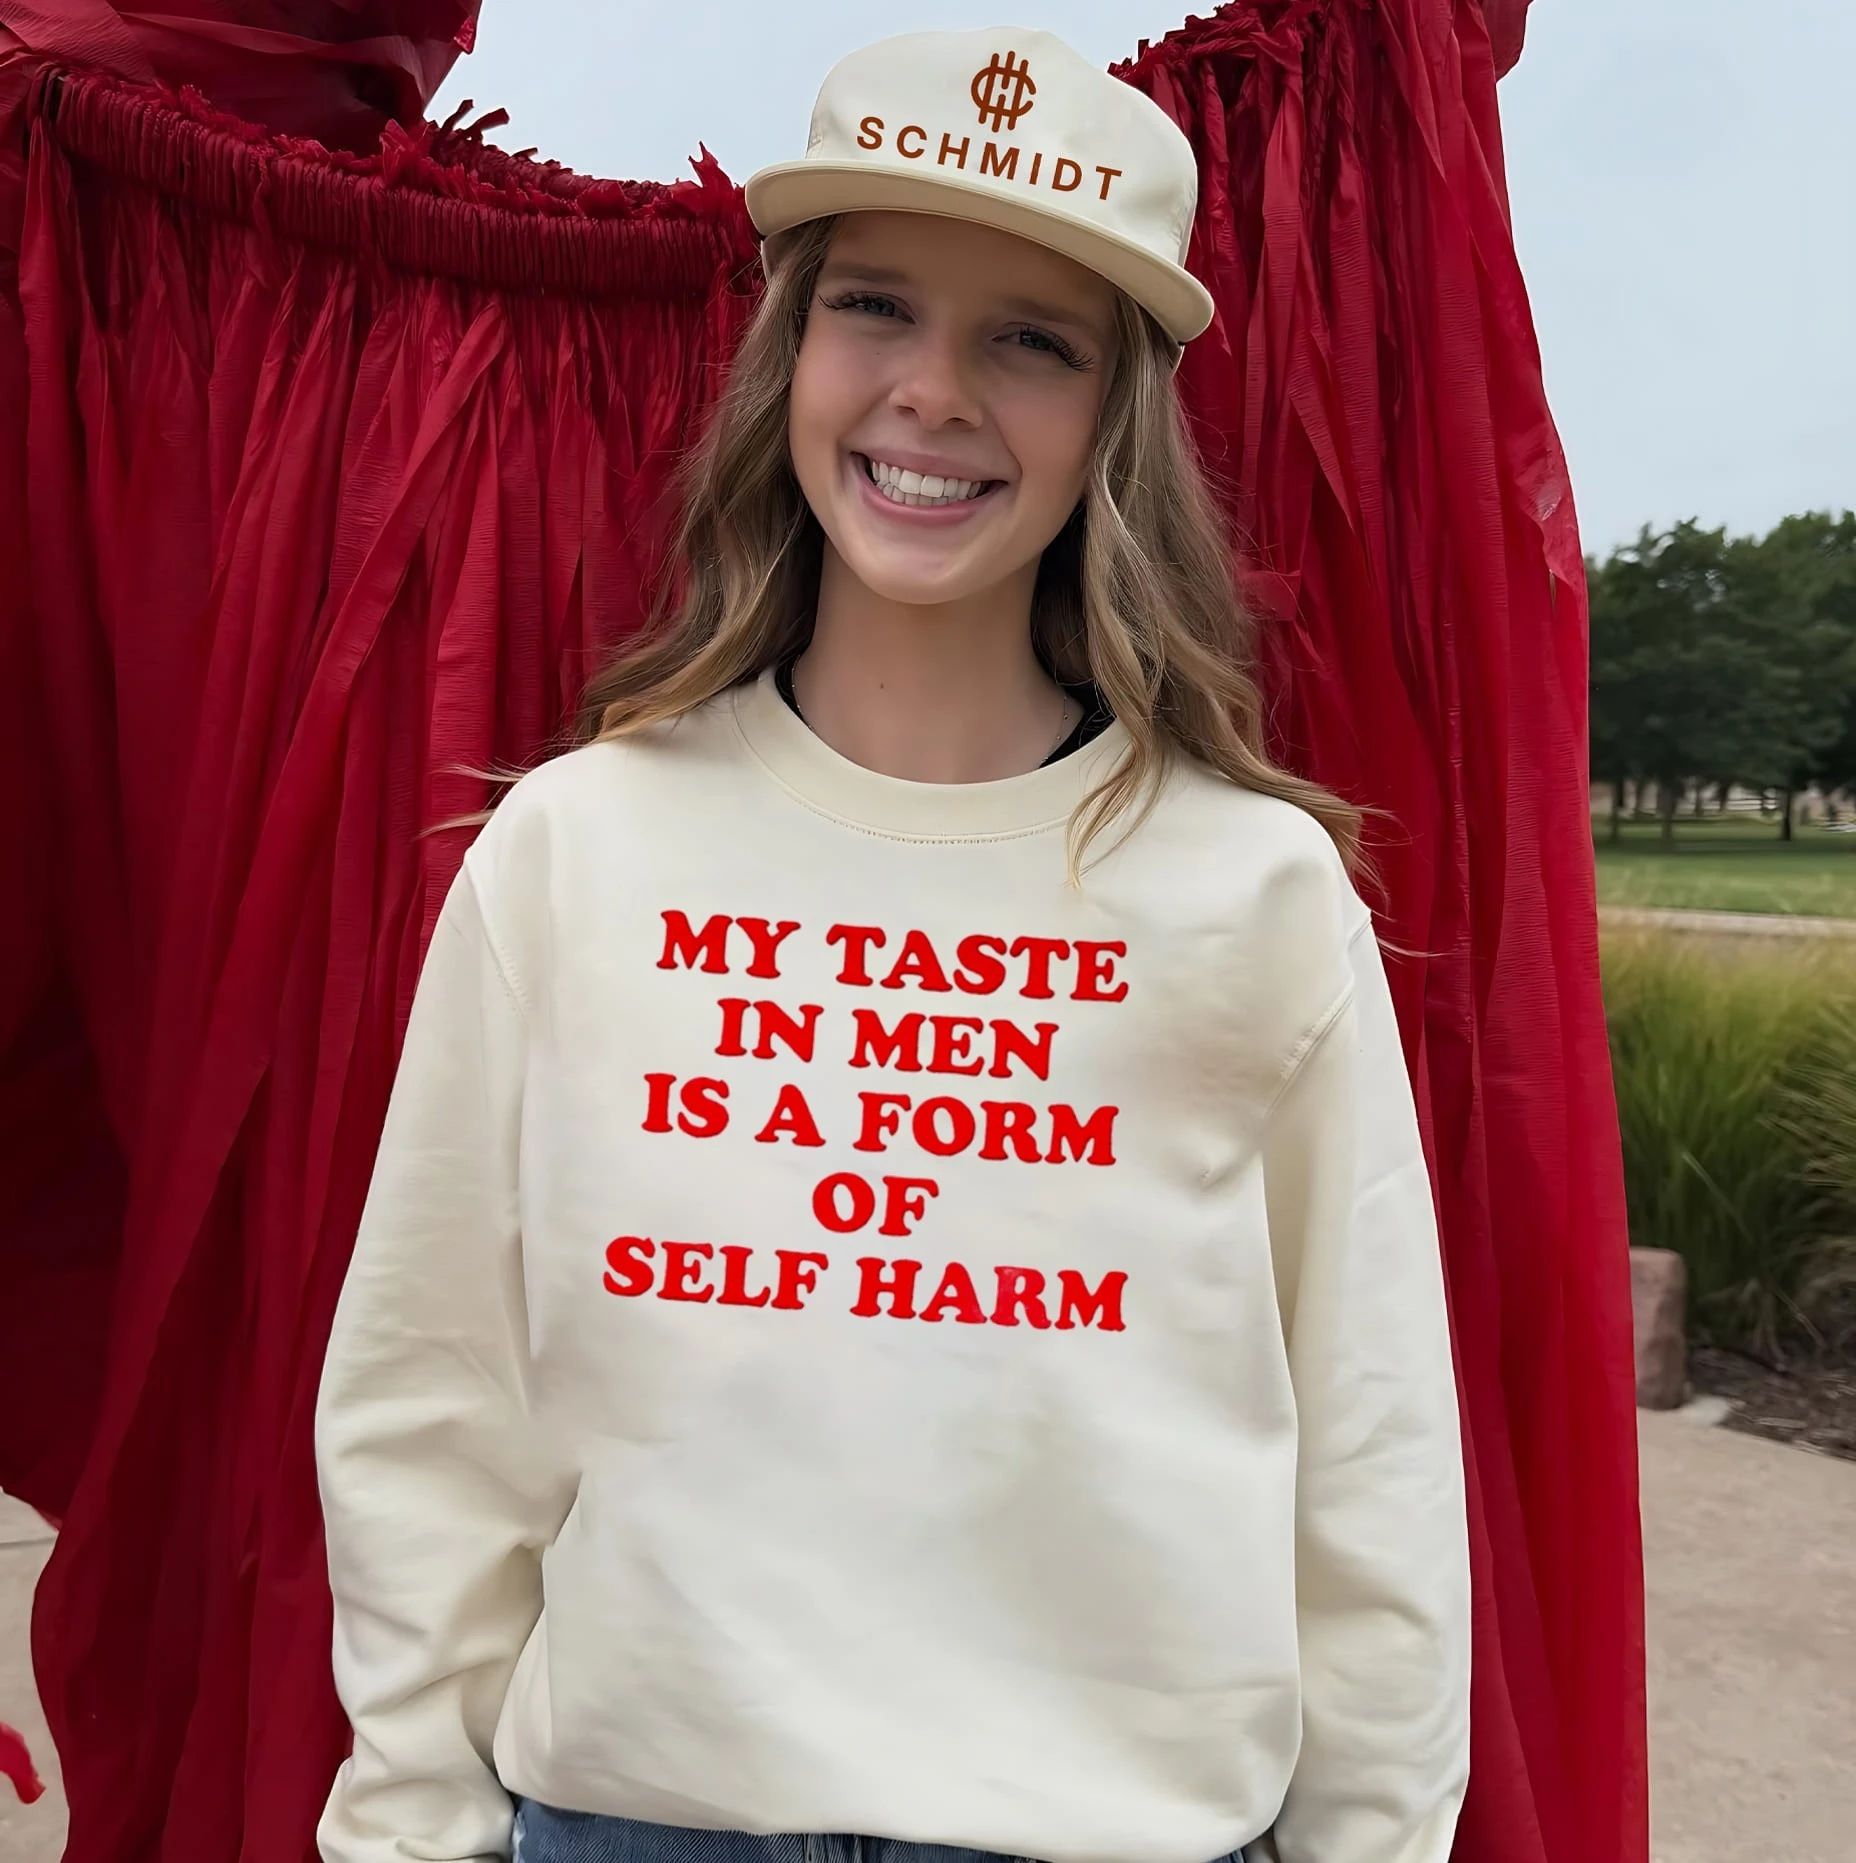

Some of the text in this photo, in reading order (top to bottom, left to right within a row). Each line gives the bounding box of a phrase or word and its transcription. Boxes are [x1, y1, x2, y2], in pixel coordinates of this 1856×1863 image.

[857, 116, 1123, 201] SCHMIDT
[655, 909, 1130, 1003] MY TASTE
[714, 997, 1059, 1081] IN MEN
[640, 1072, 1121, 1167] IS A FORM
[811, 1171, 940, 1237] OF
[601, 1235, 1129, 1332] SELF HARM
